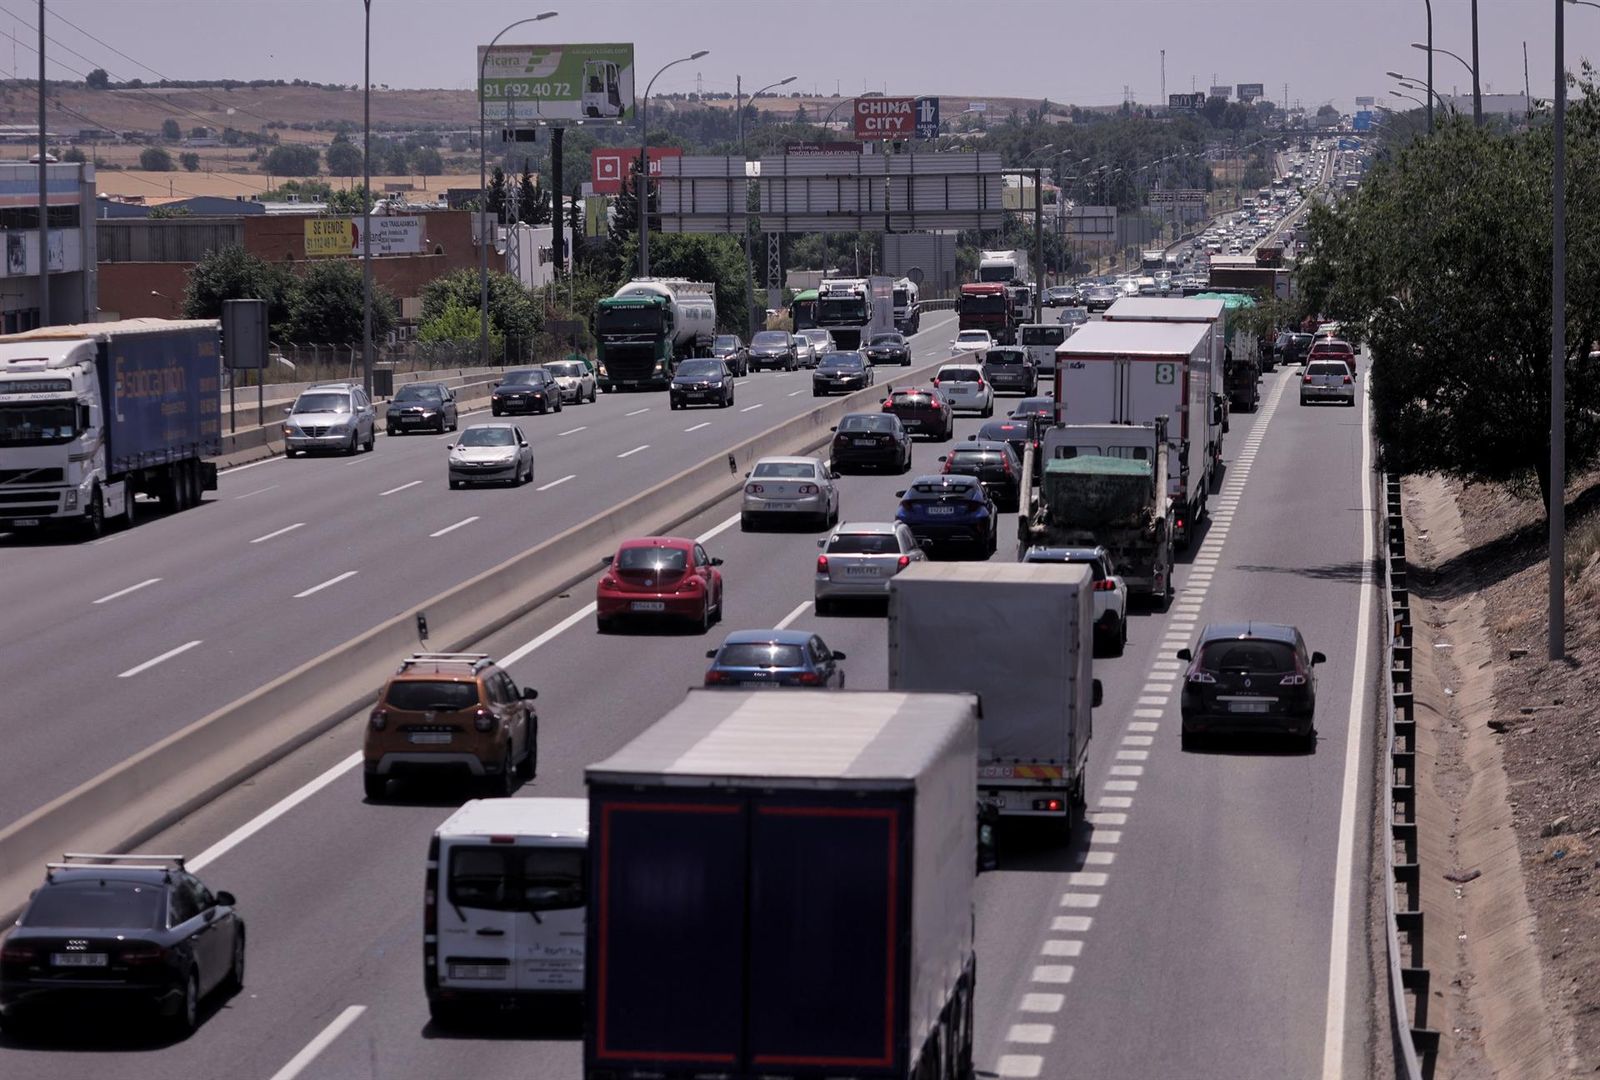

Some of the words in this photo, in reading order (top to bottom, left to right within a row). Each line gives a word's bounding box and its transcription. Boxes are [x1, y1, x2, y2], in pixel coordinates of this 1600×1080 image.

[485, 55, 520, 66] Ficara
[484, 84, 500, 97] 91
[532, 83, 551, 97] 40
[553, 82, 572, 97] 72
[858, 102, 912, 114] CHINA
[865, 117, 904, 130] CITY
[313, 221, 321, 234] SE
[323, 221, 344, 234] VENDE
[1158, 365, 1173, 383] 8
